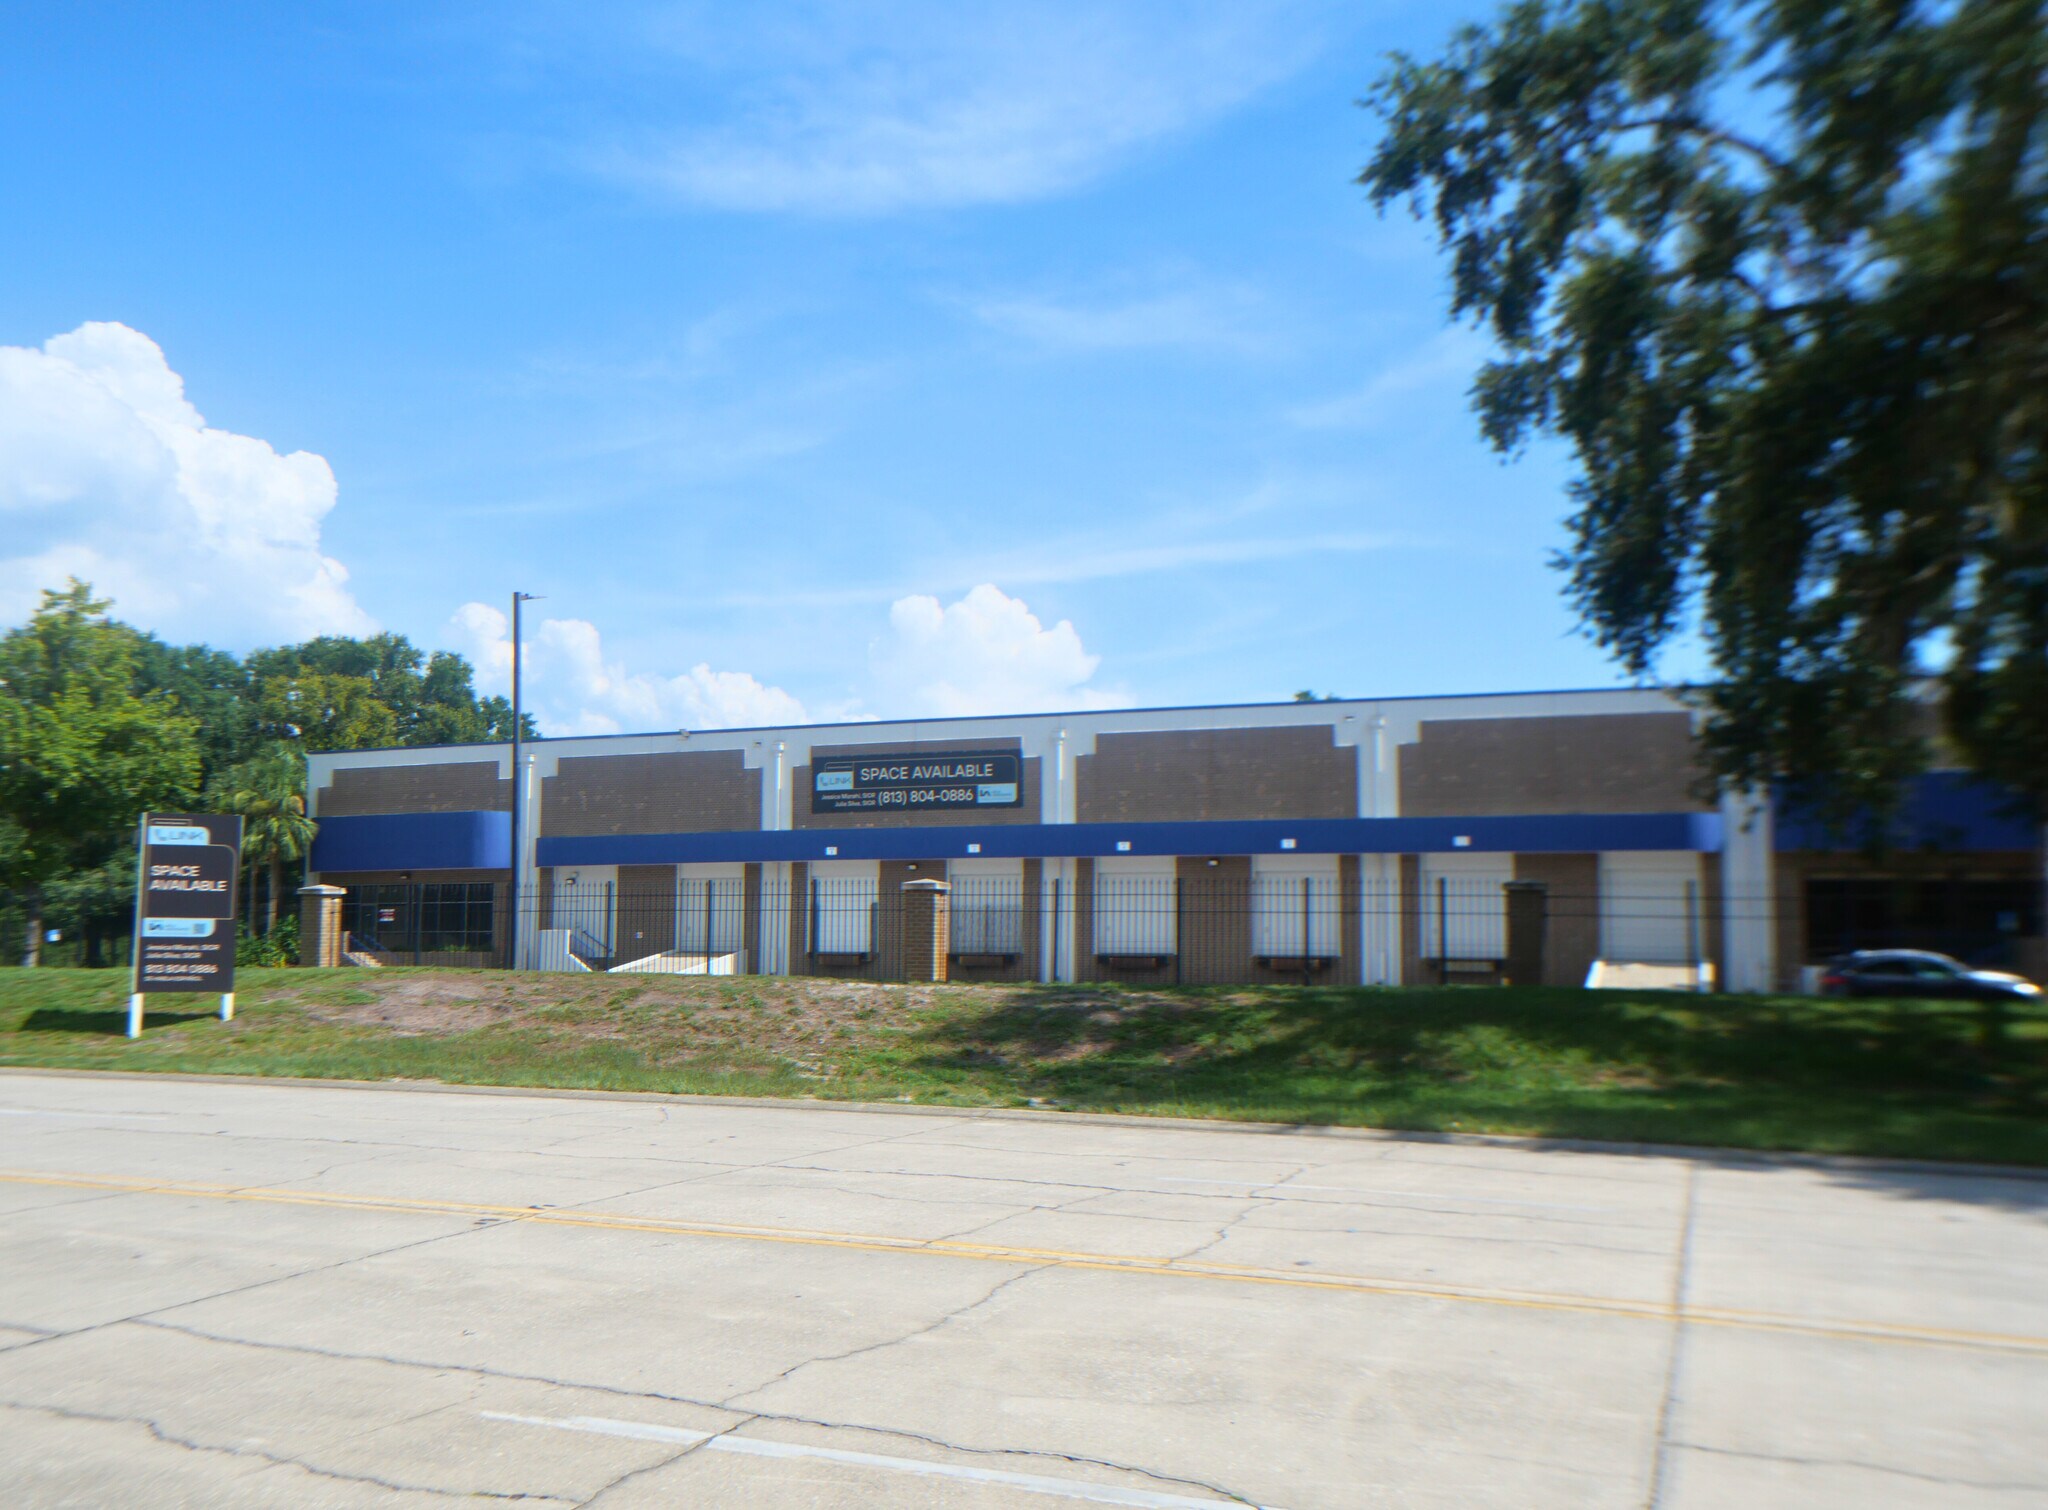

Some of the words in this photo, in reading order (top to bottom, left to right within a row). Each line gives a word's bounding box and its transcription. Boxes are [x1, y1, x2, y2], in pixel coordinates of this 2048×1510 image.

[861, 766, 909, 781] SPACE
[911, 763, 994, 779] AVAILABLE
[878, 790, 908, 806] (813)
[909, 788, 974, 803] 804-0886
[150, 864, 201, 877] SPACE
[148, 879, 228, 892] AVAILABLE
